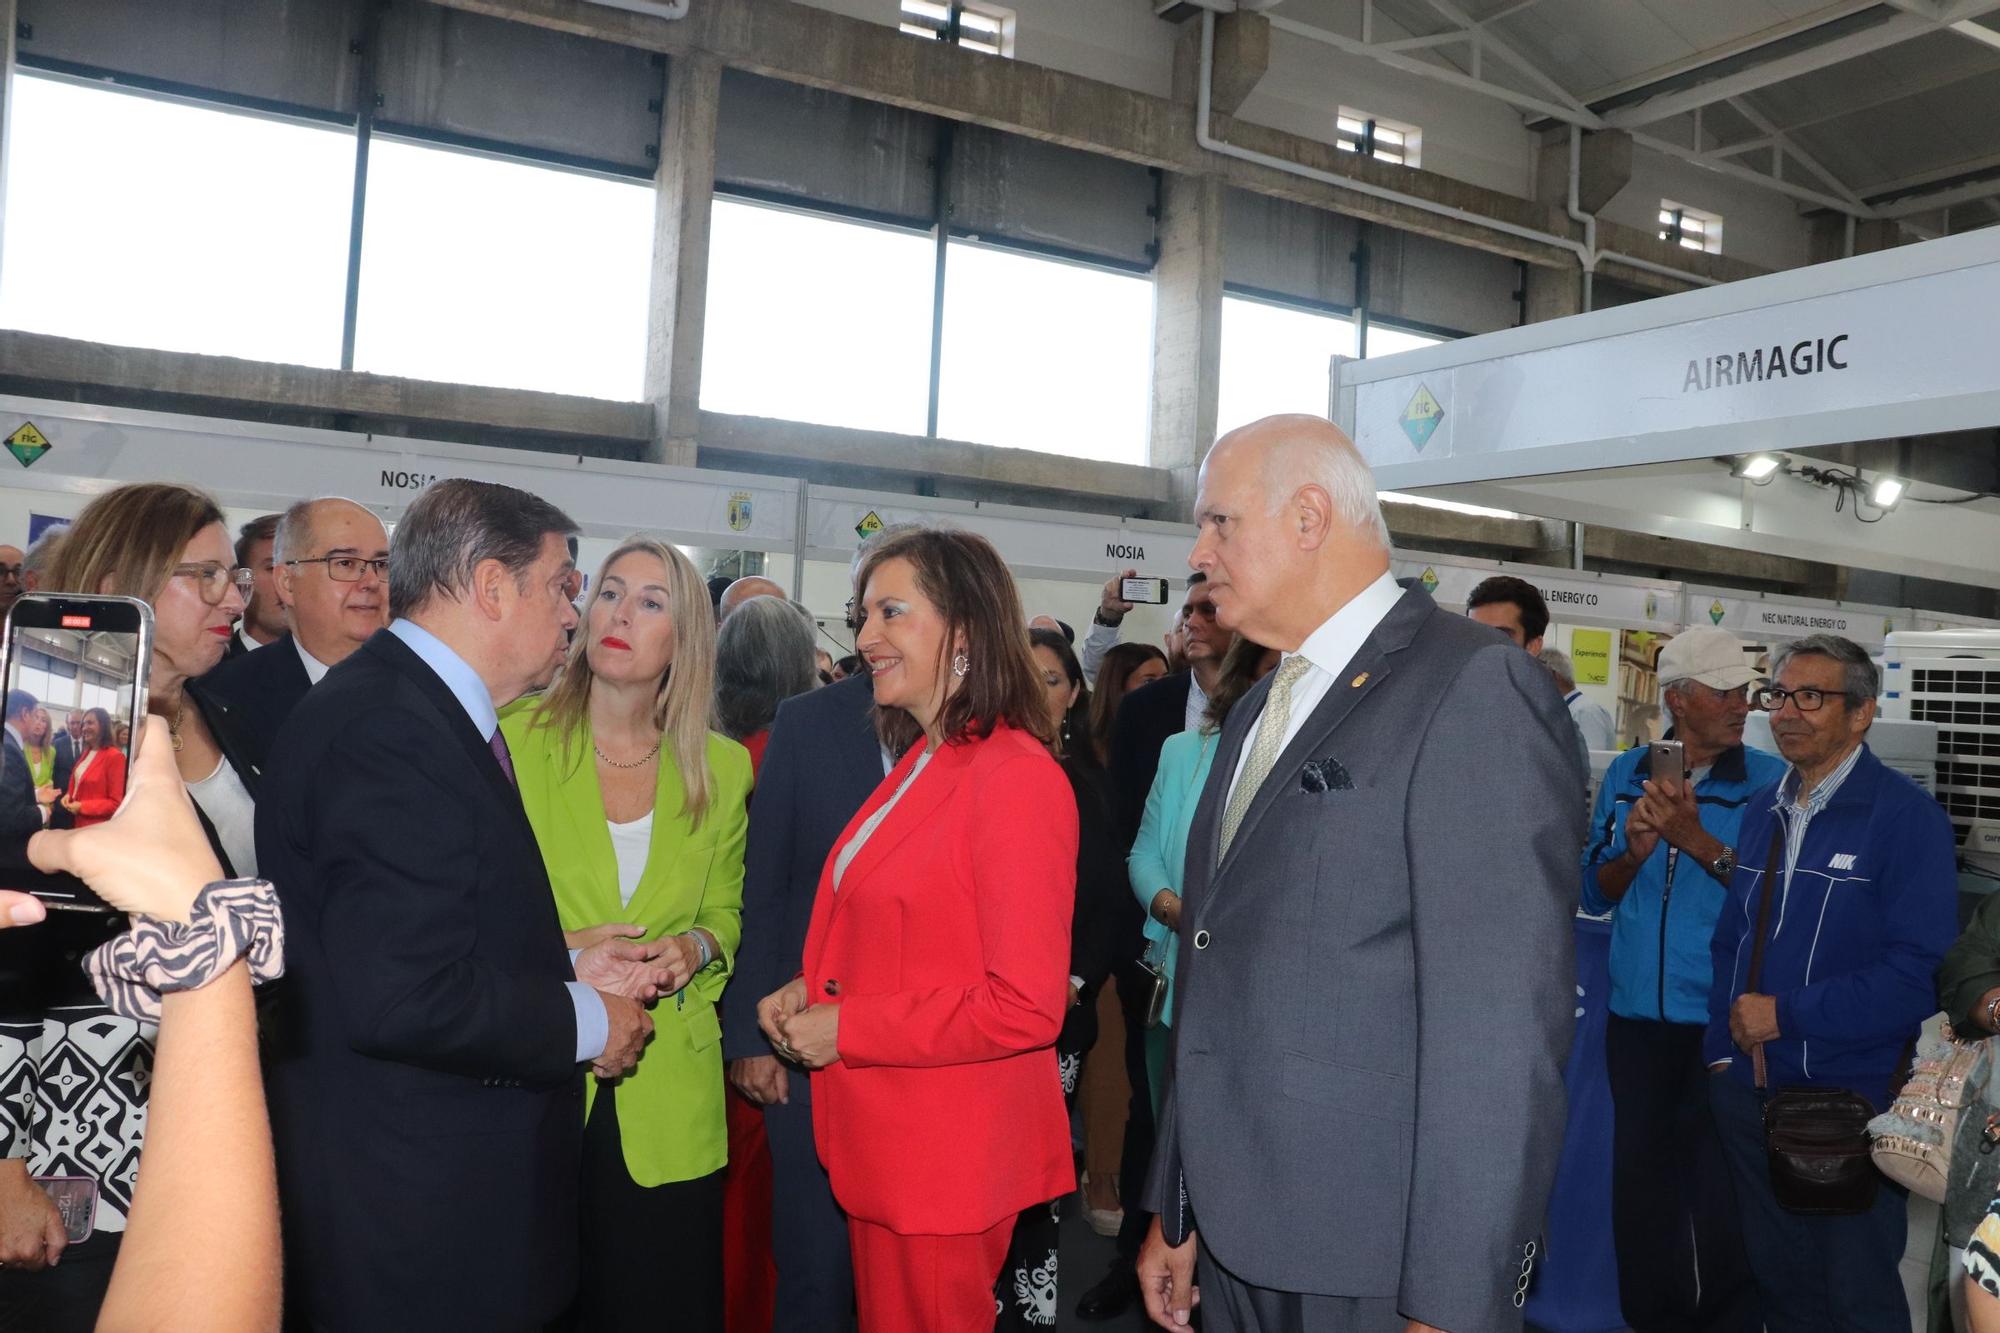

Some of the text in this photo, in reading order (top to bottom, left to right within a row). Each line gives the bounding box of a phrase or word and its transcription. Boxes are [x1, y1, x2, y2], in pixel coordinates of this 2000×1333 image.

[1683, 334, 1849, 393] AIRMAGIC
[1106, 543, 1145, 560] NOSIA
[1551, 590, 1585, 604] ENERGY
[1586, 594, 1598, 605] CO
[1762, 612, 1847, 630] NEC NATURAL ENERGY CO
[59, 1193, 71, 1227] 12:5
